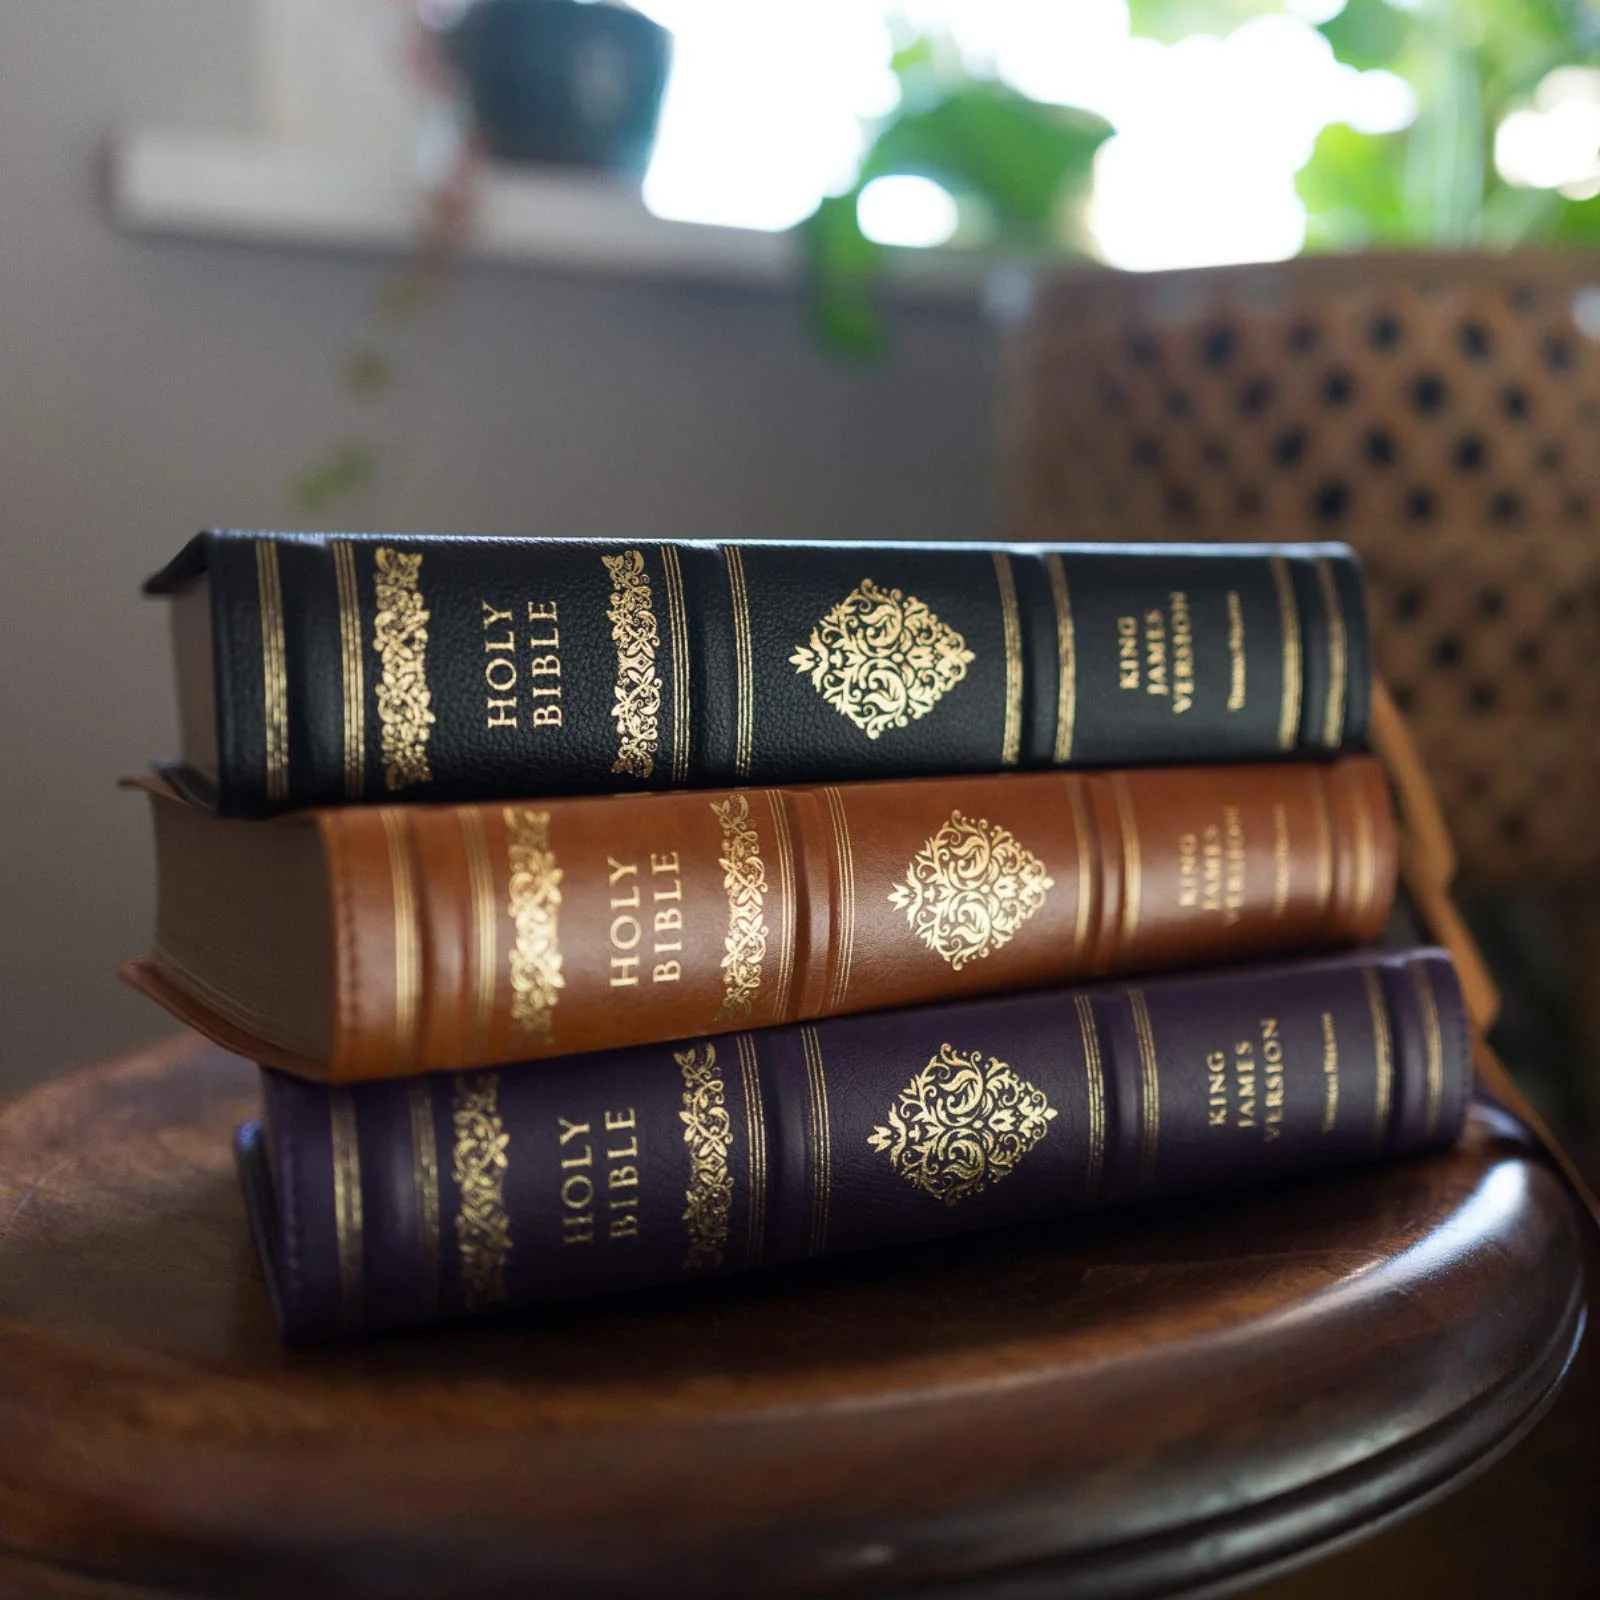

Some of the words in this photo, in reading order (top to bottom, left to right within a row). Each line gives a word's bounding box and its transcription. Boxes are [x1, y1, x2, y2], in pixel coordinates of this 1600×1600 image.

[482, 601, 517, 728] HOLY
[529, 600, 562, 727] BIBLE
[1118, 616, 1139, 689] KING
[1145, 609, 1168, 695] JAMES
[1170, 592, 1194, 714] VERSION
[608, 857, 640, 987] HOLY
[650, 851, 682, 983] BIBLE
[1207, 1051, 1228, 1127] KING
[1235, 1041, 1256, 1127] JAMES
[1261, 1018, 1284, 1142] VERSION
[558, 1116, 593, 1245] HOLY
[605, 1107, 638, 1239] BIBLE
